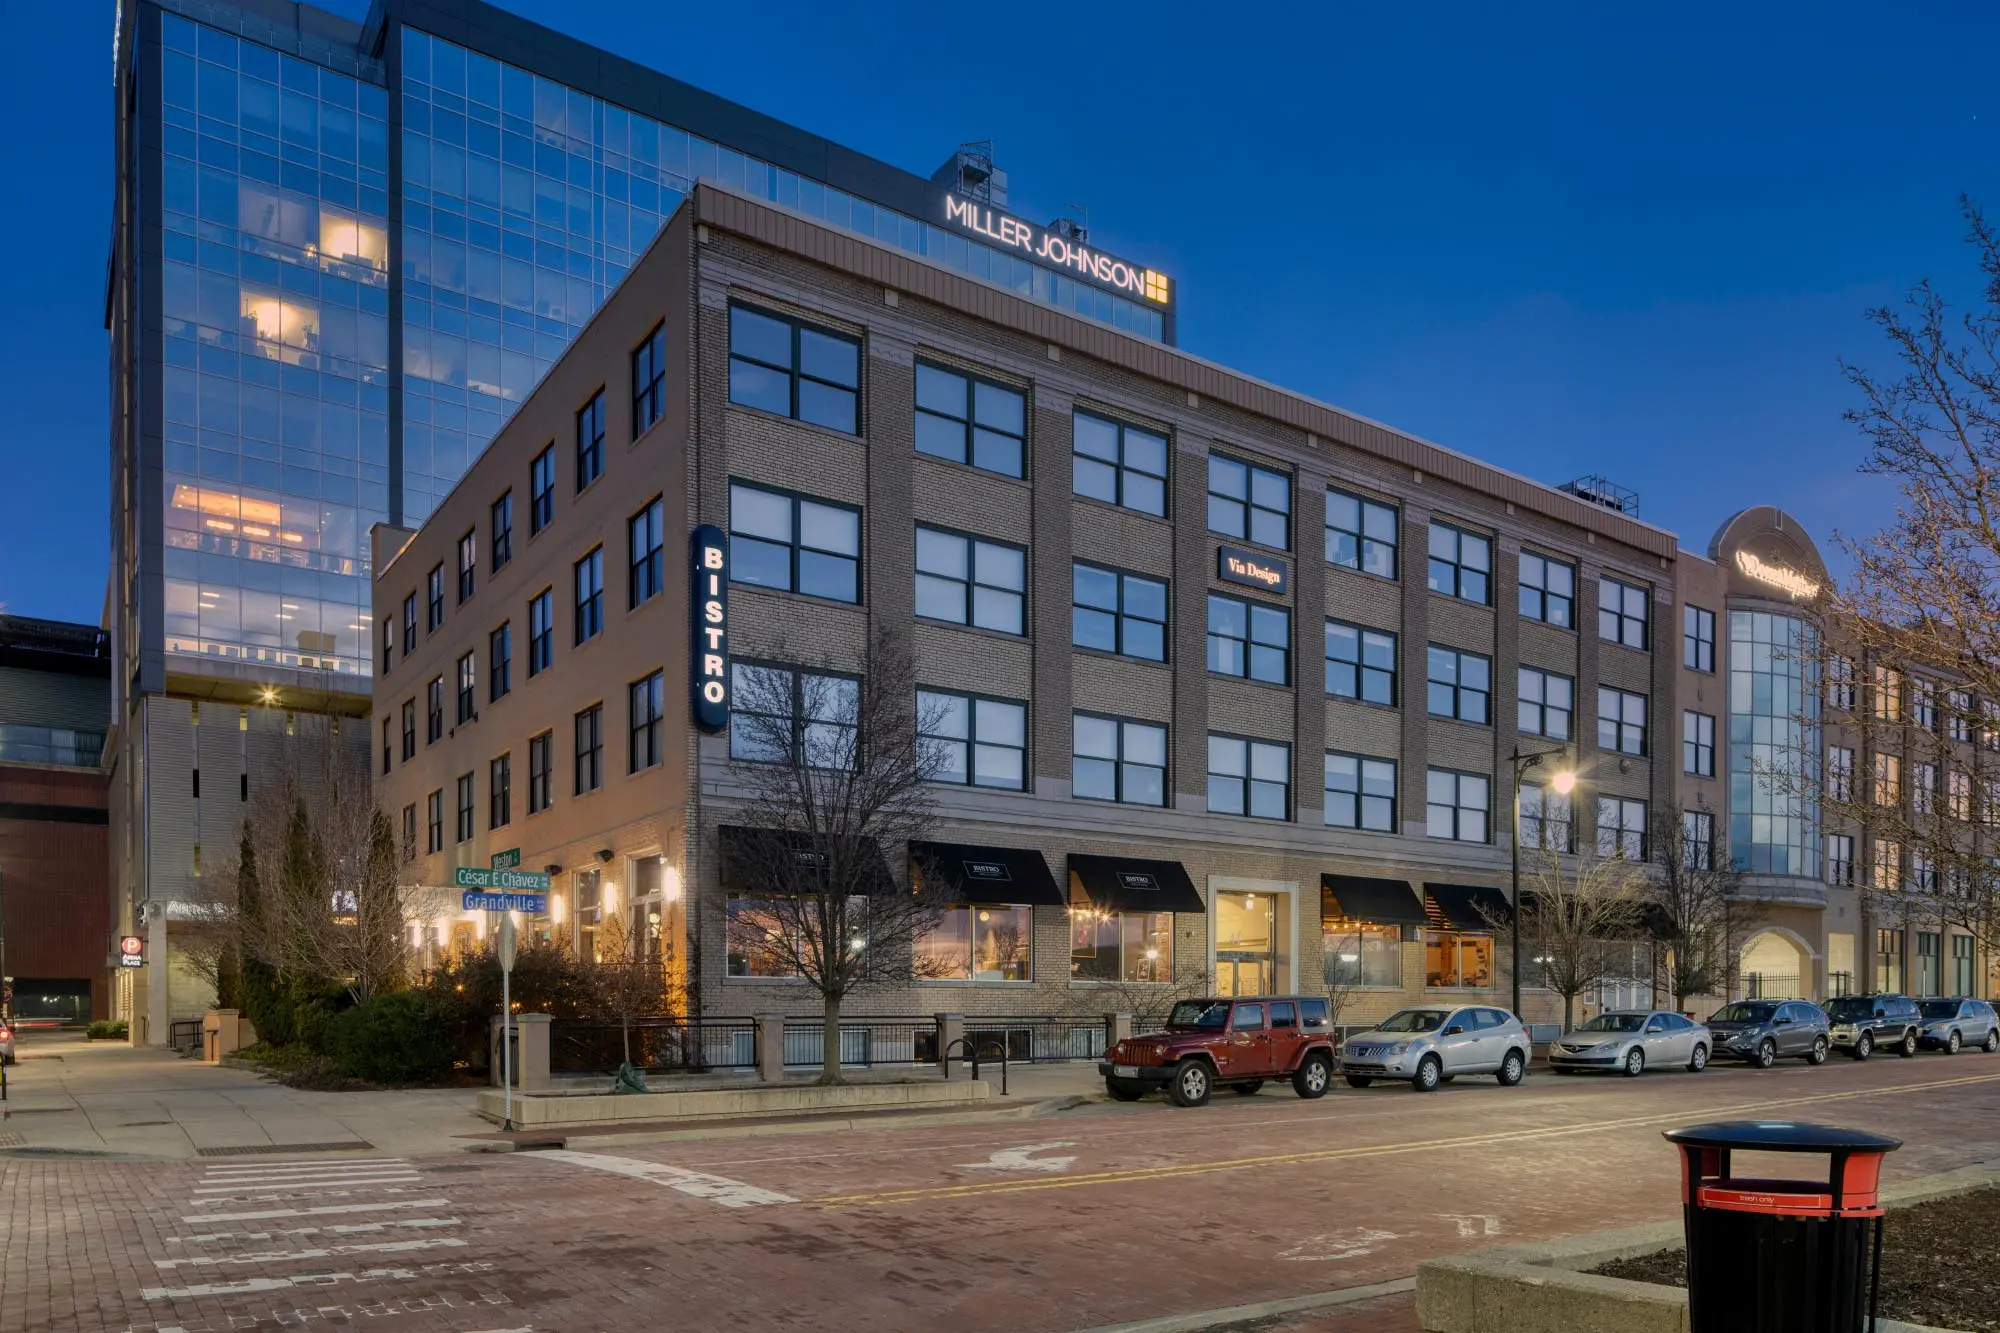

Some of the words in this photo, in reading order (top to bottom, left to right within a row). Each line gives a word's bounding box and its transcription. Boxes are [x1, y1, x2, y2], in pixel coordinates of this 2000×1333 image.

[946, 195, 1032, 252] MILLER
[1036, 234, 1144, 296] JOHNSON
[1228, 557, 1245, 574] Via
[1247, 563, 1280, 585] Design
[704, 546, 724, 703] BISTRO
[458, 869, 489, 885] César
[493, 872, 498, 885] E
[501, 872, 539, 888] Chávez
[465, 895, 534, 911] Grandville
[127, 939, 138, 952] P
[1759, 1196, 1775, 1204] only
